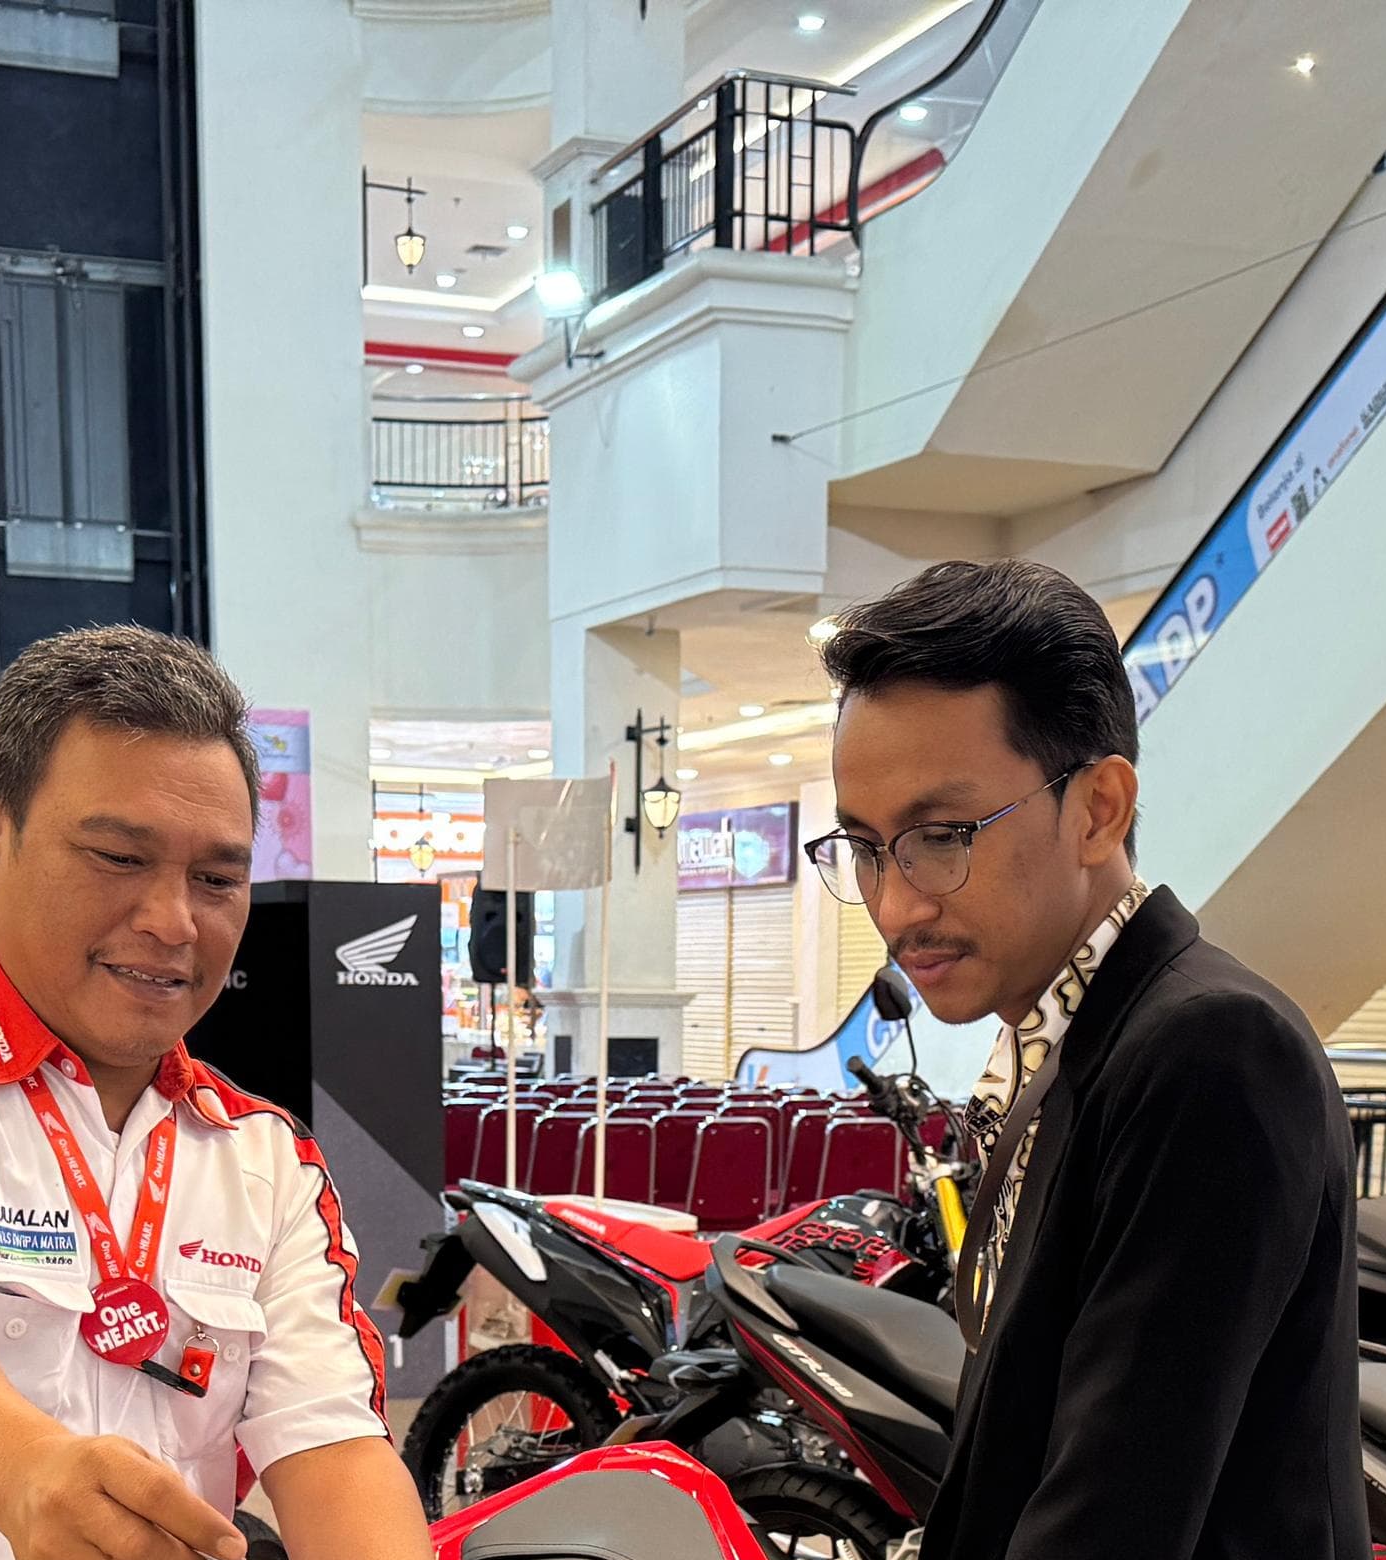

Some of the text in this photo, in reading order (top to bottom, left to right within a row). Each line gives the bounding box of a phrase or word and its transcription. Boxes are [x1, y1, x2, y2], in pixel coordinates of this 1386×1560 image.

[336, 971, 420, 986] HONDA
[59, 1138, 73, 1159] One
[100, 1240, 112, 1261] One
[202, 1248, 262, 1274] HOND
[99, 1300, 142, 1327] One
[94, 1311, 165, 1354] HEART.
